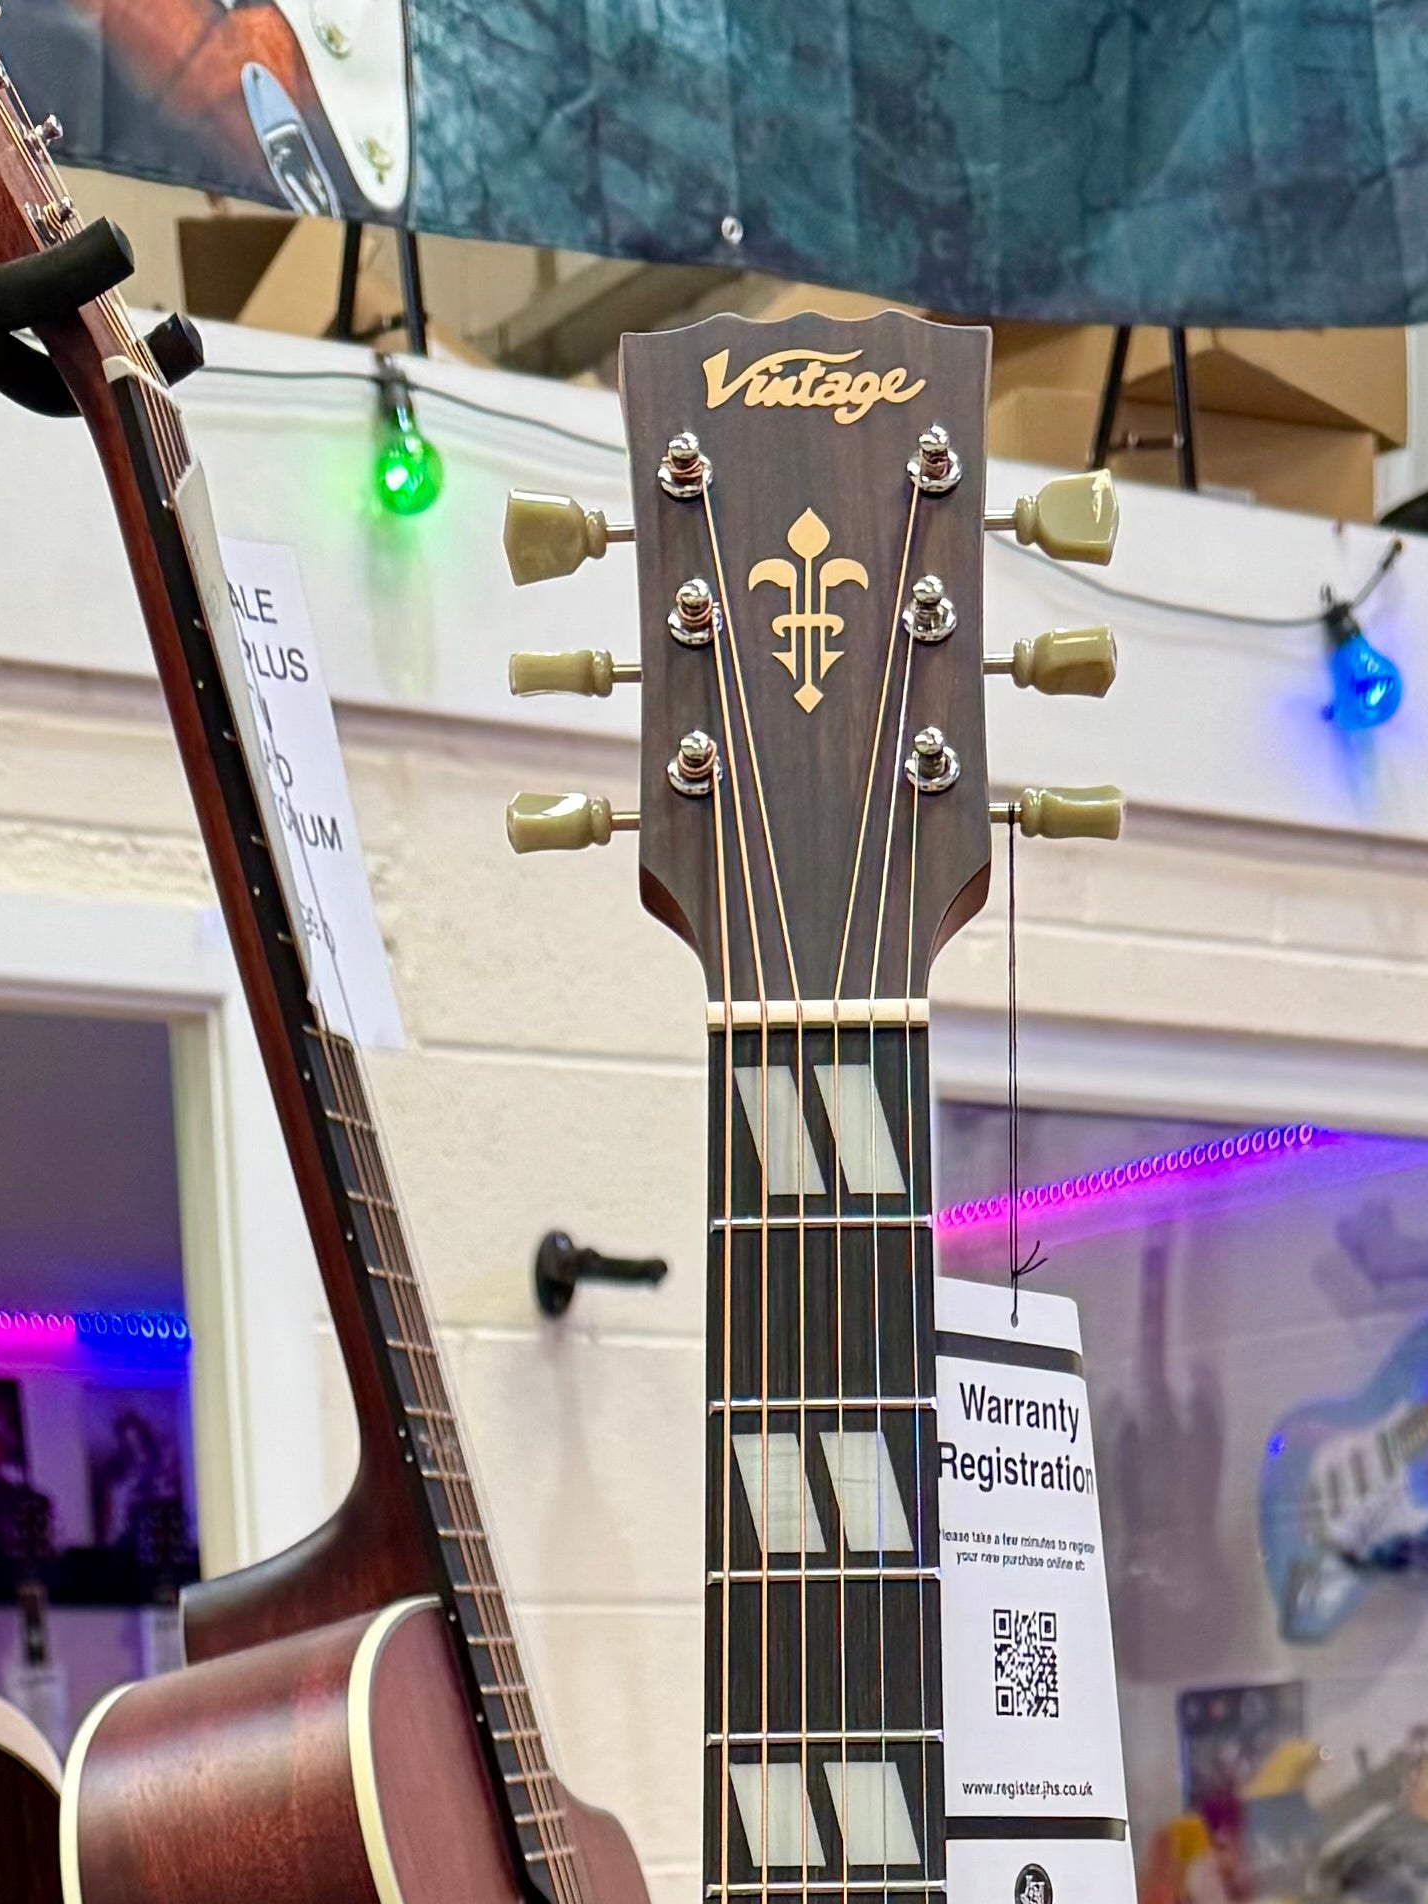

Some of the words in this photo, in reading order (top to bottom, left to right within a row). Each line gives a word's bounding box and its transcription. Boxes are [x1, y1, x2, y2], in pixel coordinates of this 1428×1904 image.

[701, 348, 927, 426] Vintage
[959, 1382, 1080, 1444] Warranty
[938, 1441, 1095, 1496] Registration
[941, 1528, 971, 1543] lease
[994, 1535, 1001, 1546] a
